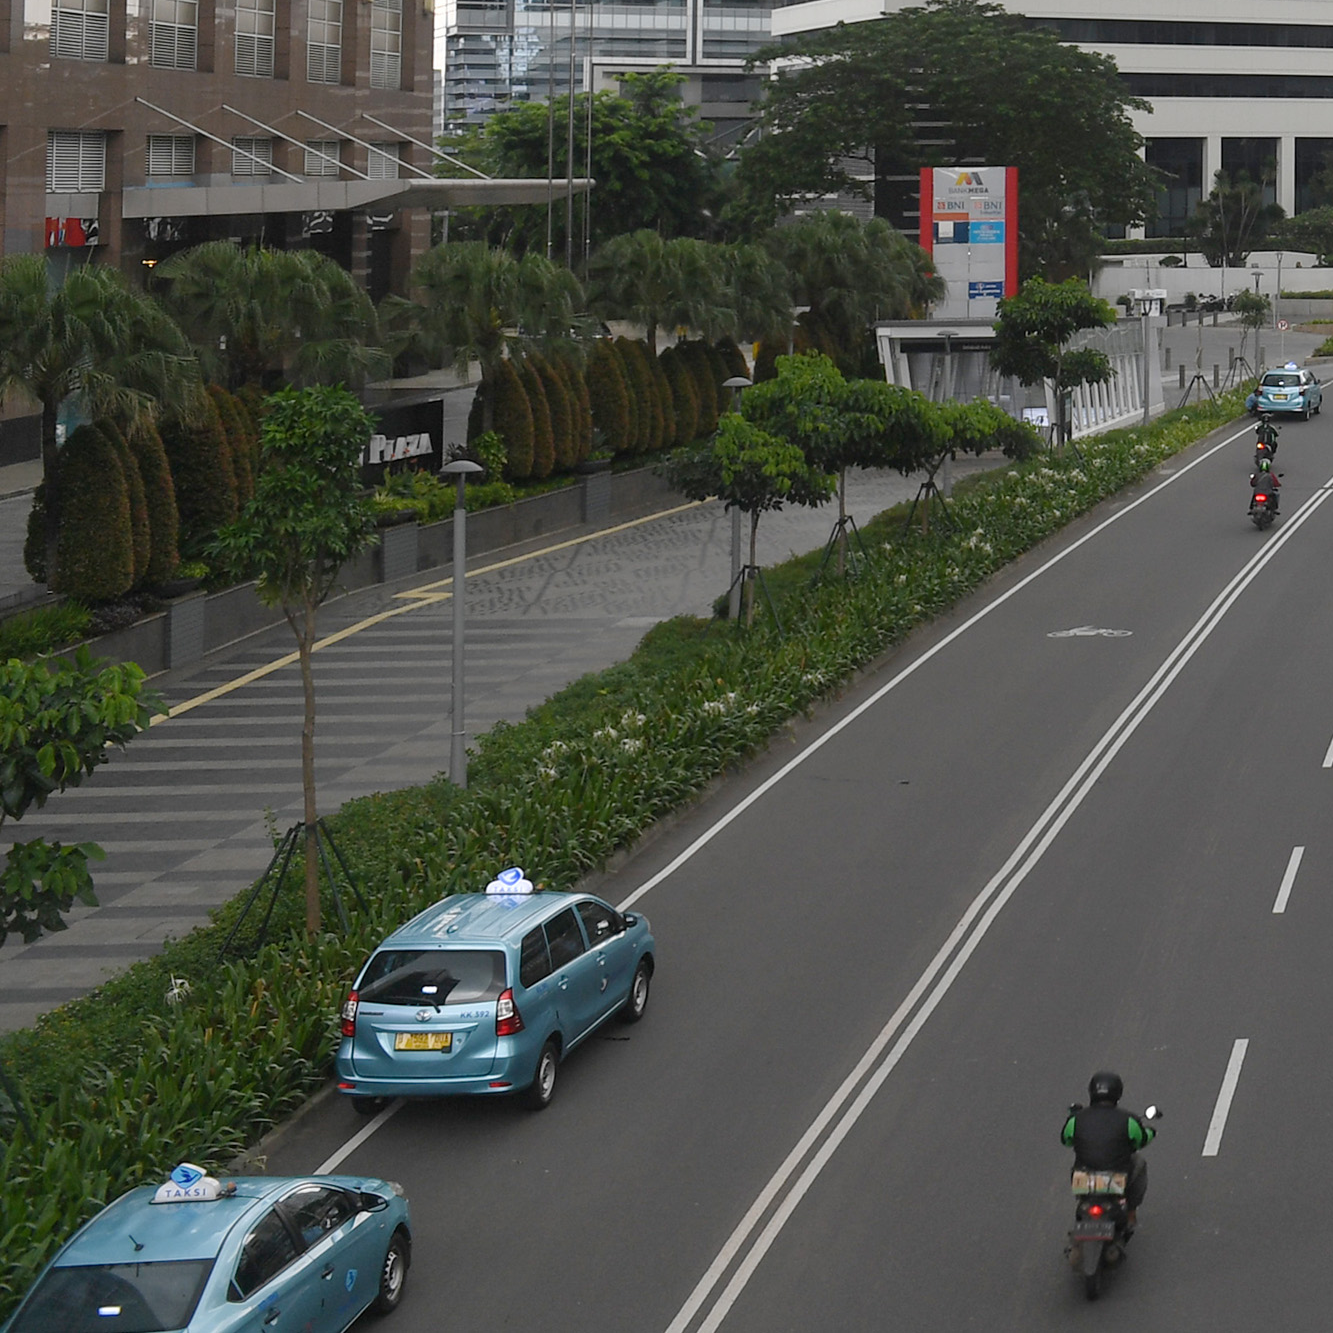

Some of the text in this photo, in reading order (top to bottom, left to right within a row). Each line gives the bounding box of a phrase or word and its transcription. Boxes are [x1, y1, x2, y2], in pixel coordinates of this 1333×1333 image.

[947, 201, 965, 210] BNI
[983, 201, 1002, 210] BNI
[368, 432, 434, 464] PLAZA
[493, 885, 524, 893] TAKSI
[165, 1188, 207, 1198] TAKSI
